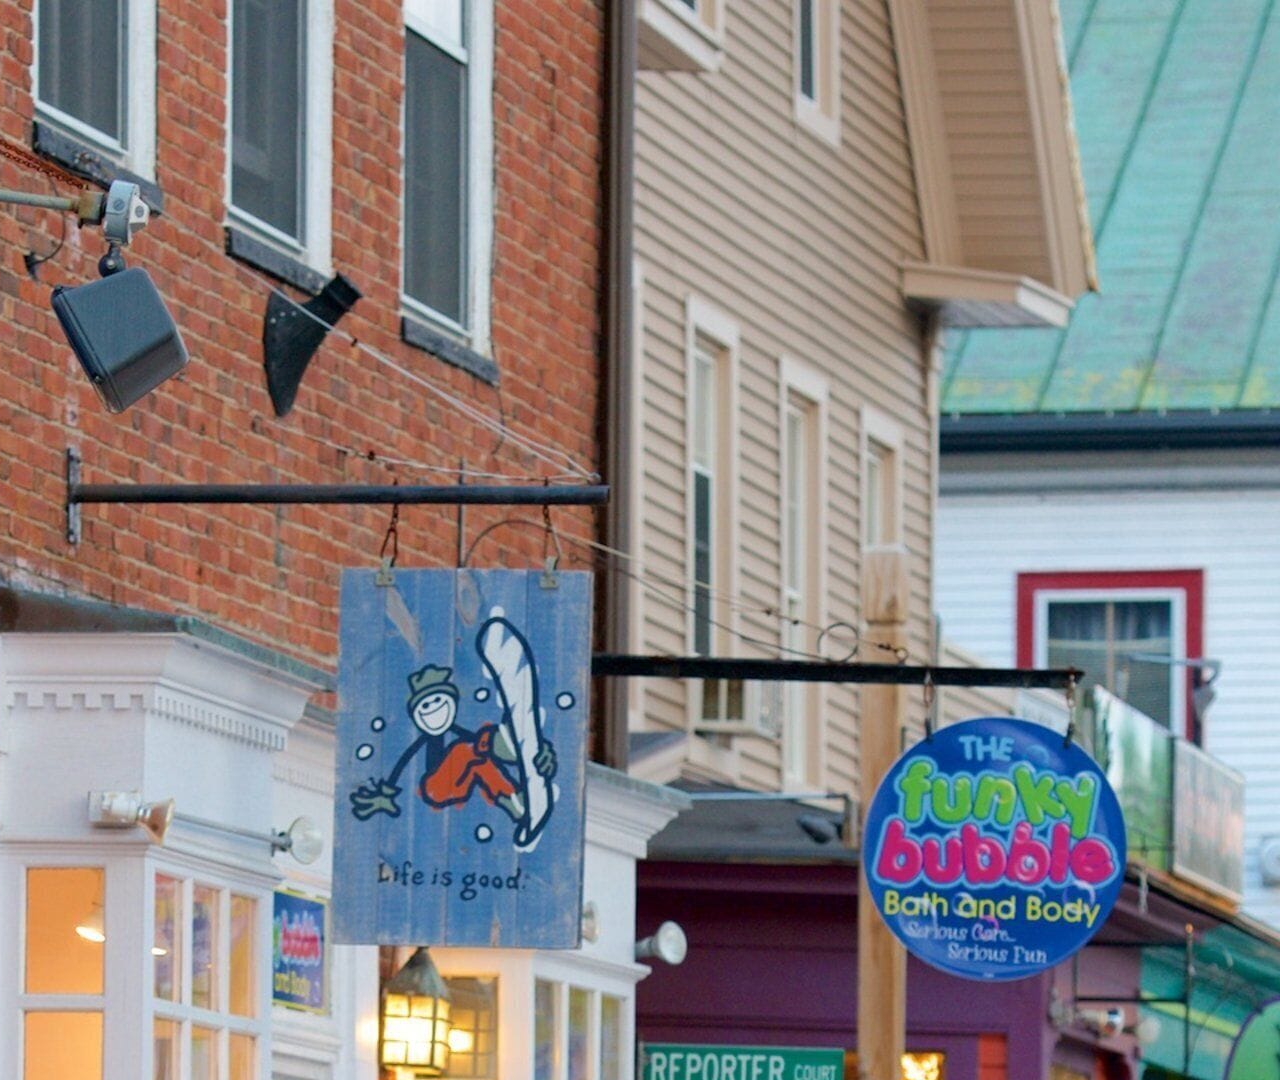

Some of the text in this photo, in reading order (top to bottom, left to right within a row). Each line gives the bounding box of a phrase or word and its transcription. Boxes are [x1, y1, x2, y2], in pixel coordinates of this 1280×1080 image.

[958, 735, 1015, 761] THE
[898, 758, 1096, 840] funky
[876, 818, 1116, 885] bubble
[377, 860, 425, 886] Life
[431, 868, 453, 887] is
[883, 890, 1100, 928] Bath and Body
[909, 920, 968, 940] Serious
[948, 942, 1047, 964] Serious Fun
